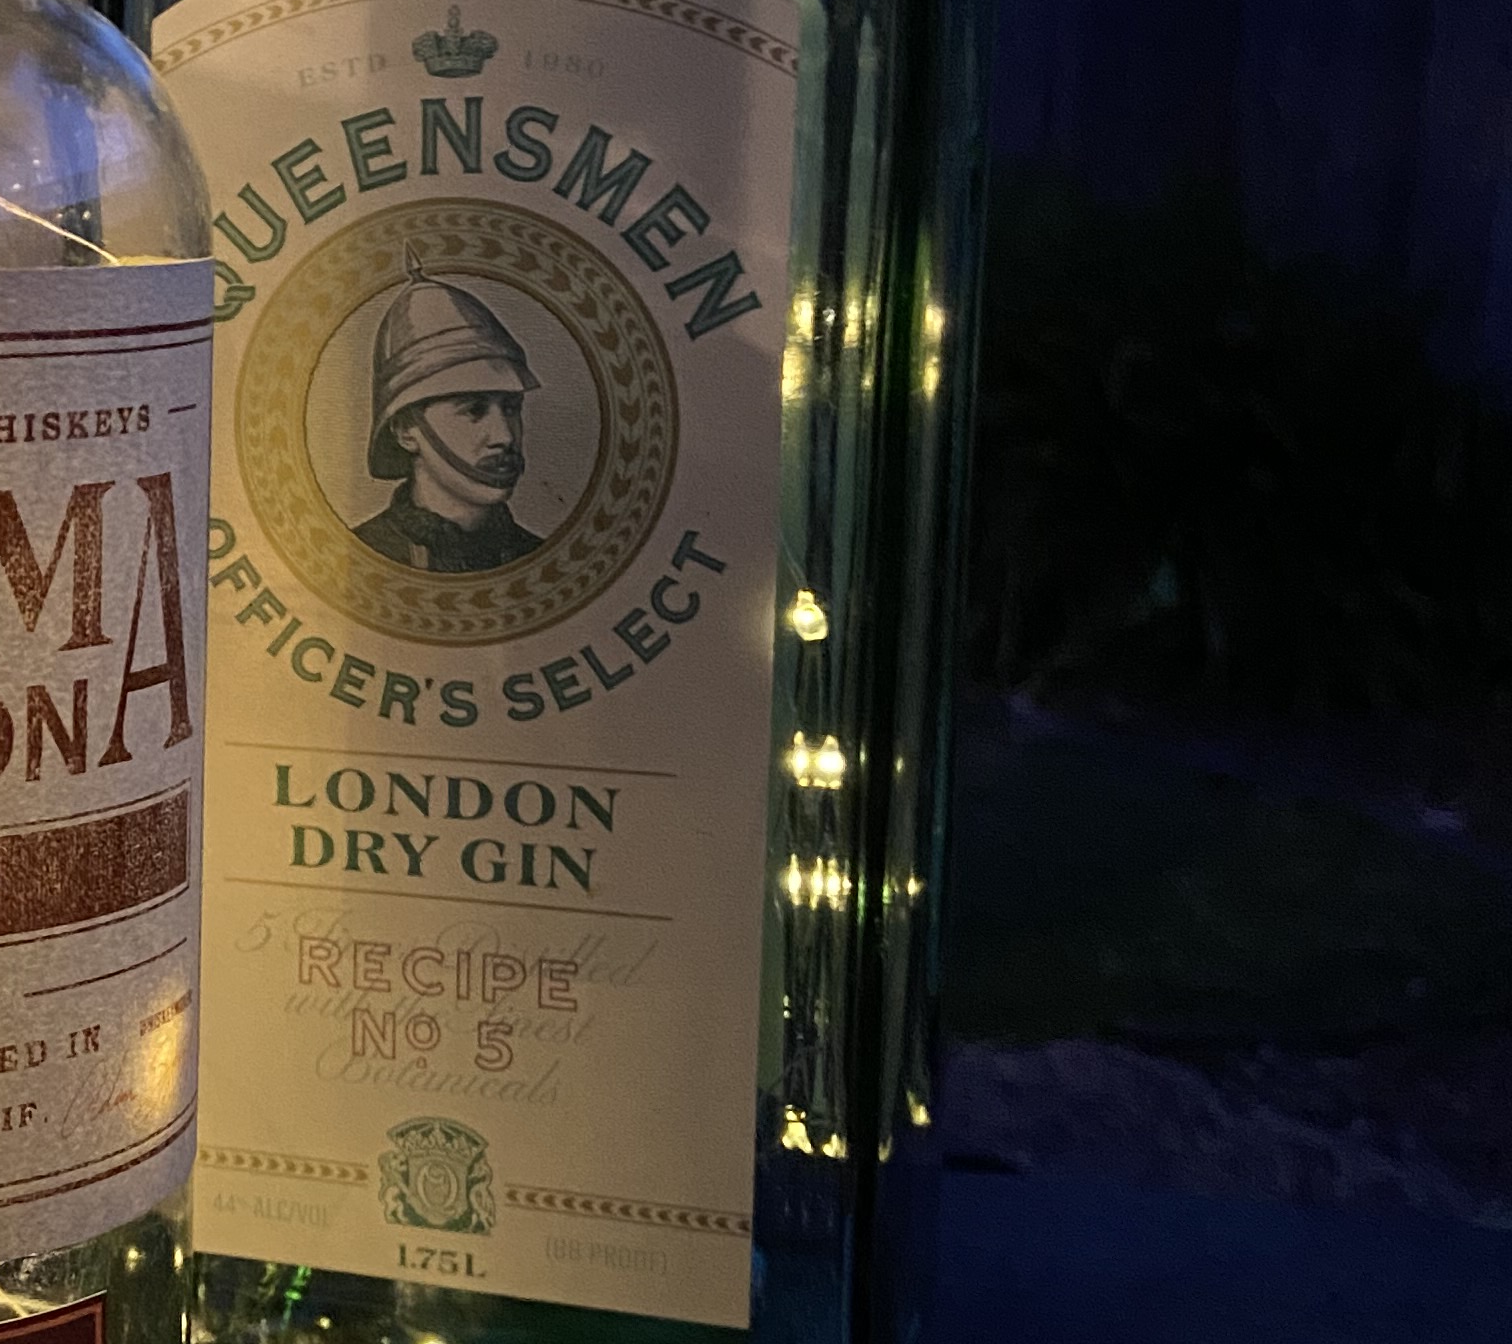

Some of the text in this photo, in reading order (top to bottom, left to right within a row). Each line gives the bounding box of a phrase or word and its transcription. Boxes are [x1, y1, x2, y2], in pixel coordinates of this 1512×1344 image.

[502, 530, 728, 724] SELECT
[271, 763, 623, 834] LONDON
[288, 823, 598, 893] DRY GIN
[298, 936, 580, 1013] RECIPE
[66, 1023, 102, 1059] IN
[474, 1020, 514, 1073] 5
